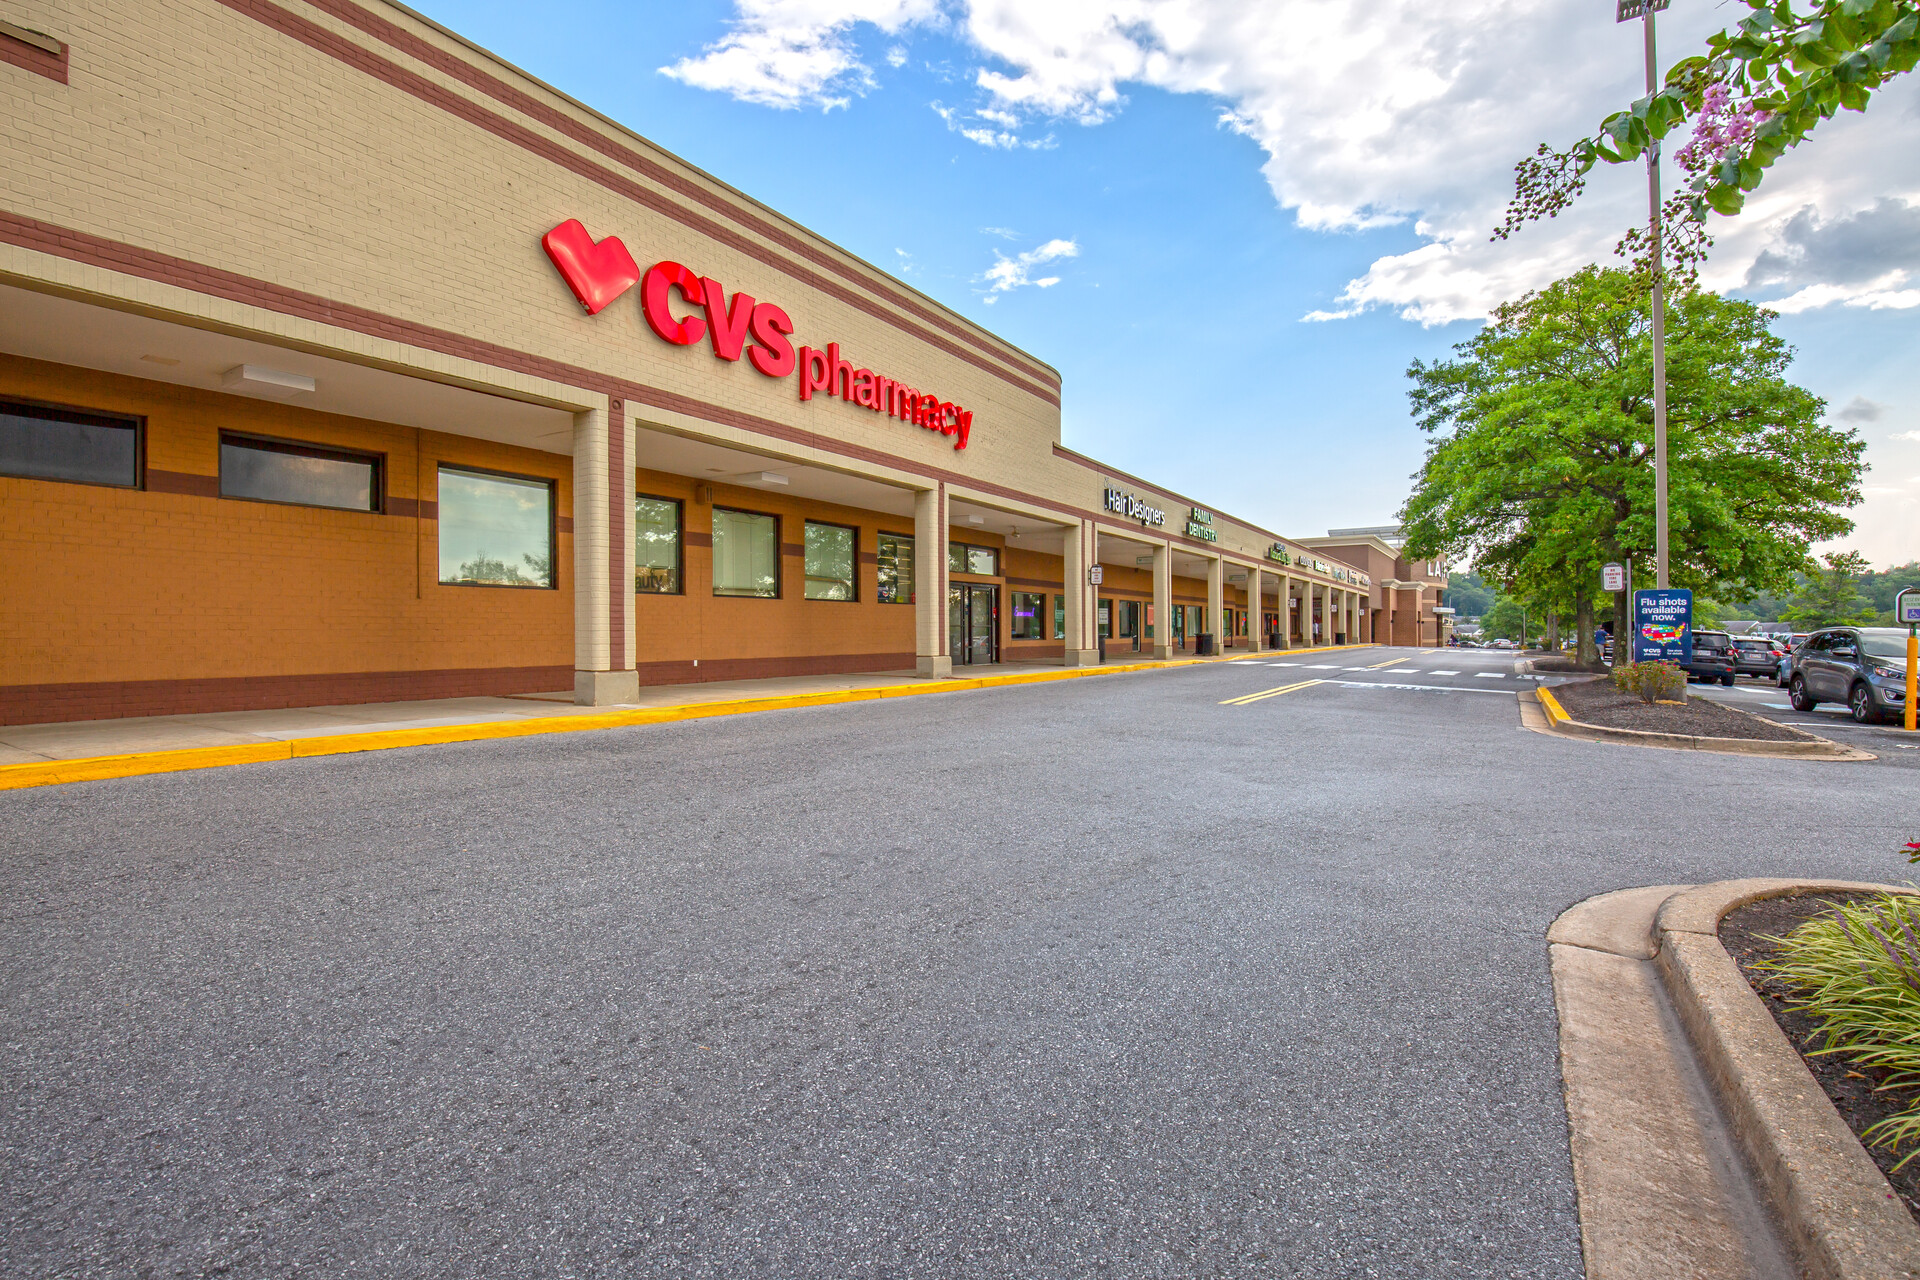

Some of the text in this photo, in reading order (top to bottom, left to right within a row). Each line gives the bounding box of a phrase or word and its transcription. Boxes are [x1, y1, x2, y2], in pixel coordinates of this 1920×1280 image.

[641, 260, 796, 378] CVS
[799, 341, 974, 451] pharmacy
[1107, 488, 1166, 526] Hair Designers
[1192, 507, 1214, 525] FAMILY
[1188, 522, 1218, 542] DENTISTRY
[635, 571, 664, 593] auty
[1640, 598, 1687, 606] Flu shots
[1641, 606, 1686, 614] available
